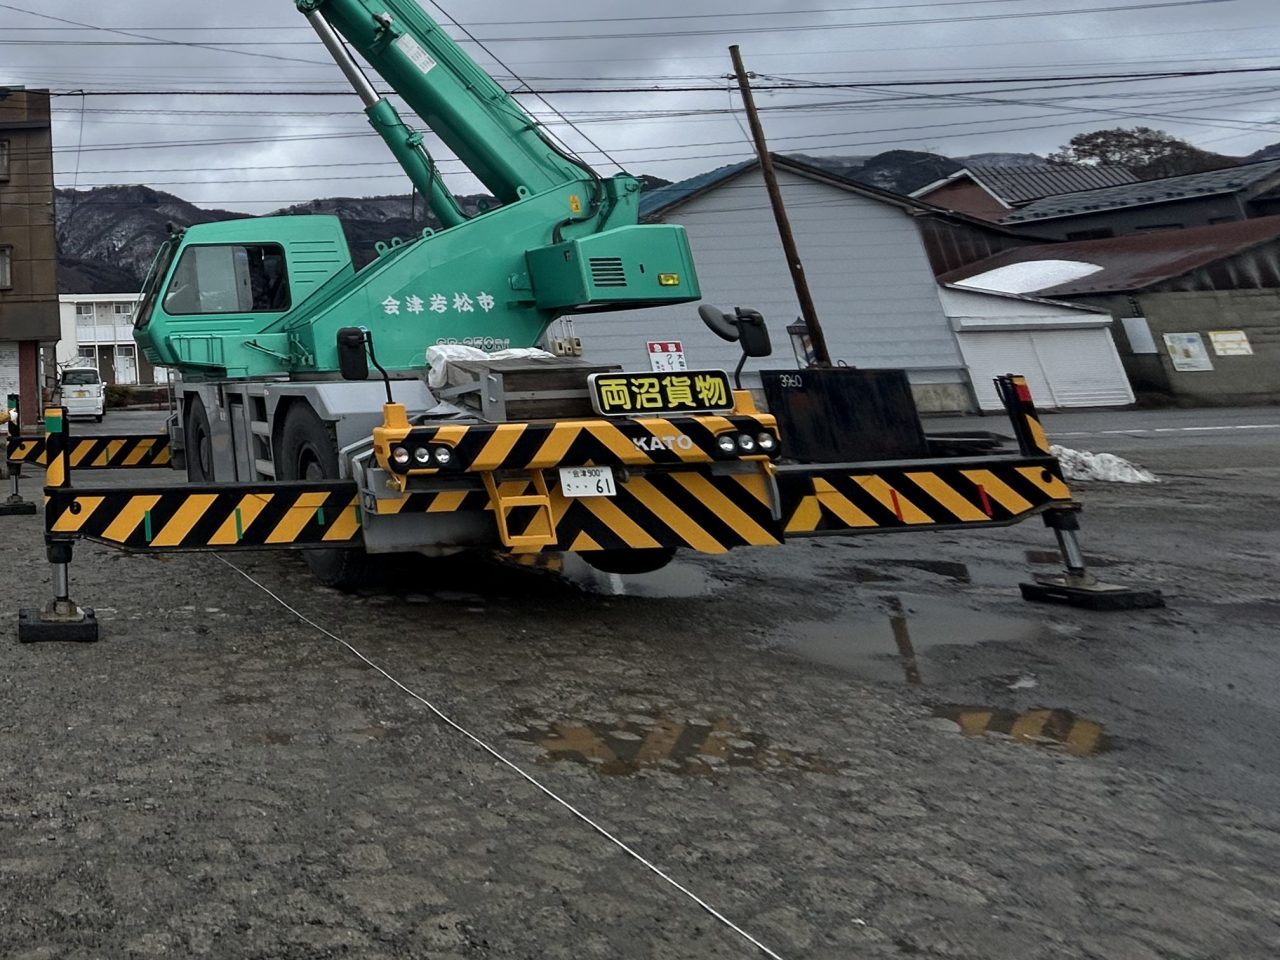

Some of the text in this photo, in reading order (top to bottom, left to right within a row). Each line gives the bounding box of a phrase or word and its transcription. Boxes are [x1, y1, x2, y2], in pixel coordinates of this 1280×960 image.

[381, 291, 496, 315] 会津若松市
[598, 375, 727, 411] 両沼貨物
[632, 434, 693, 451] KATO
